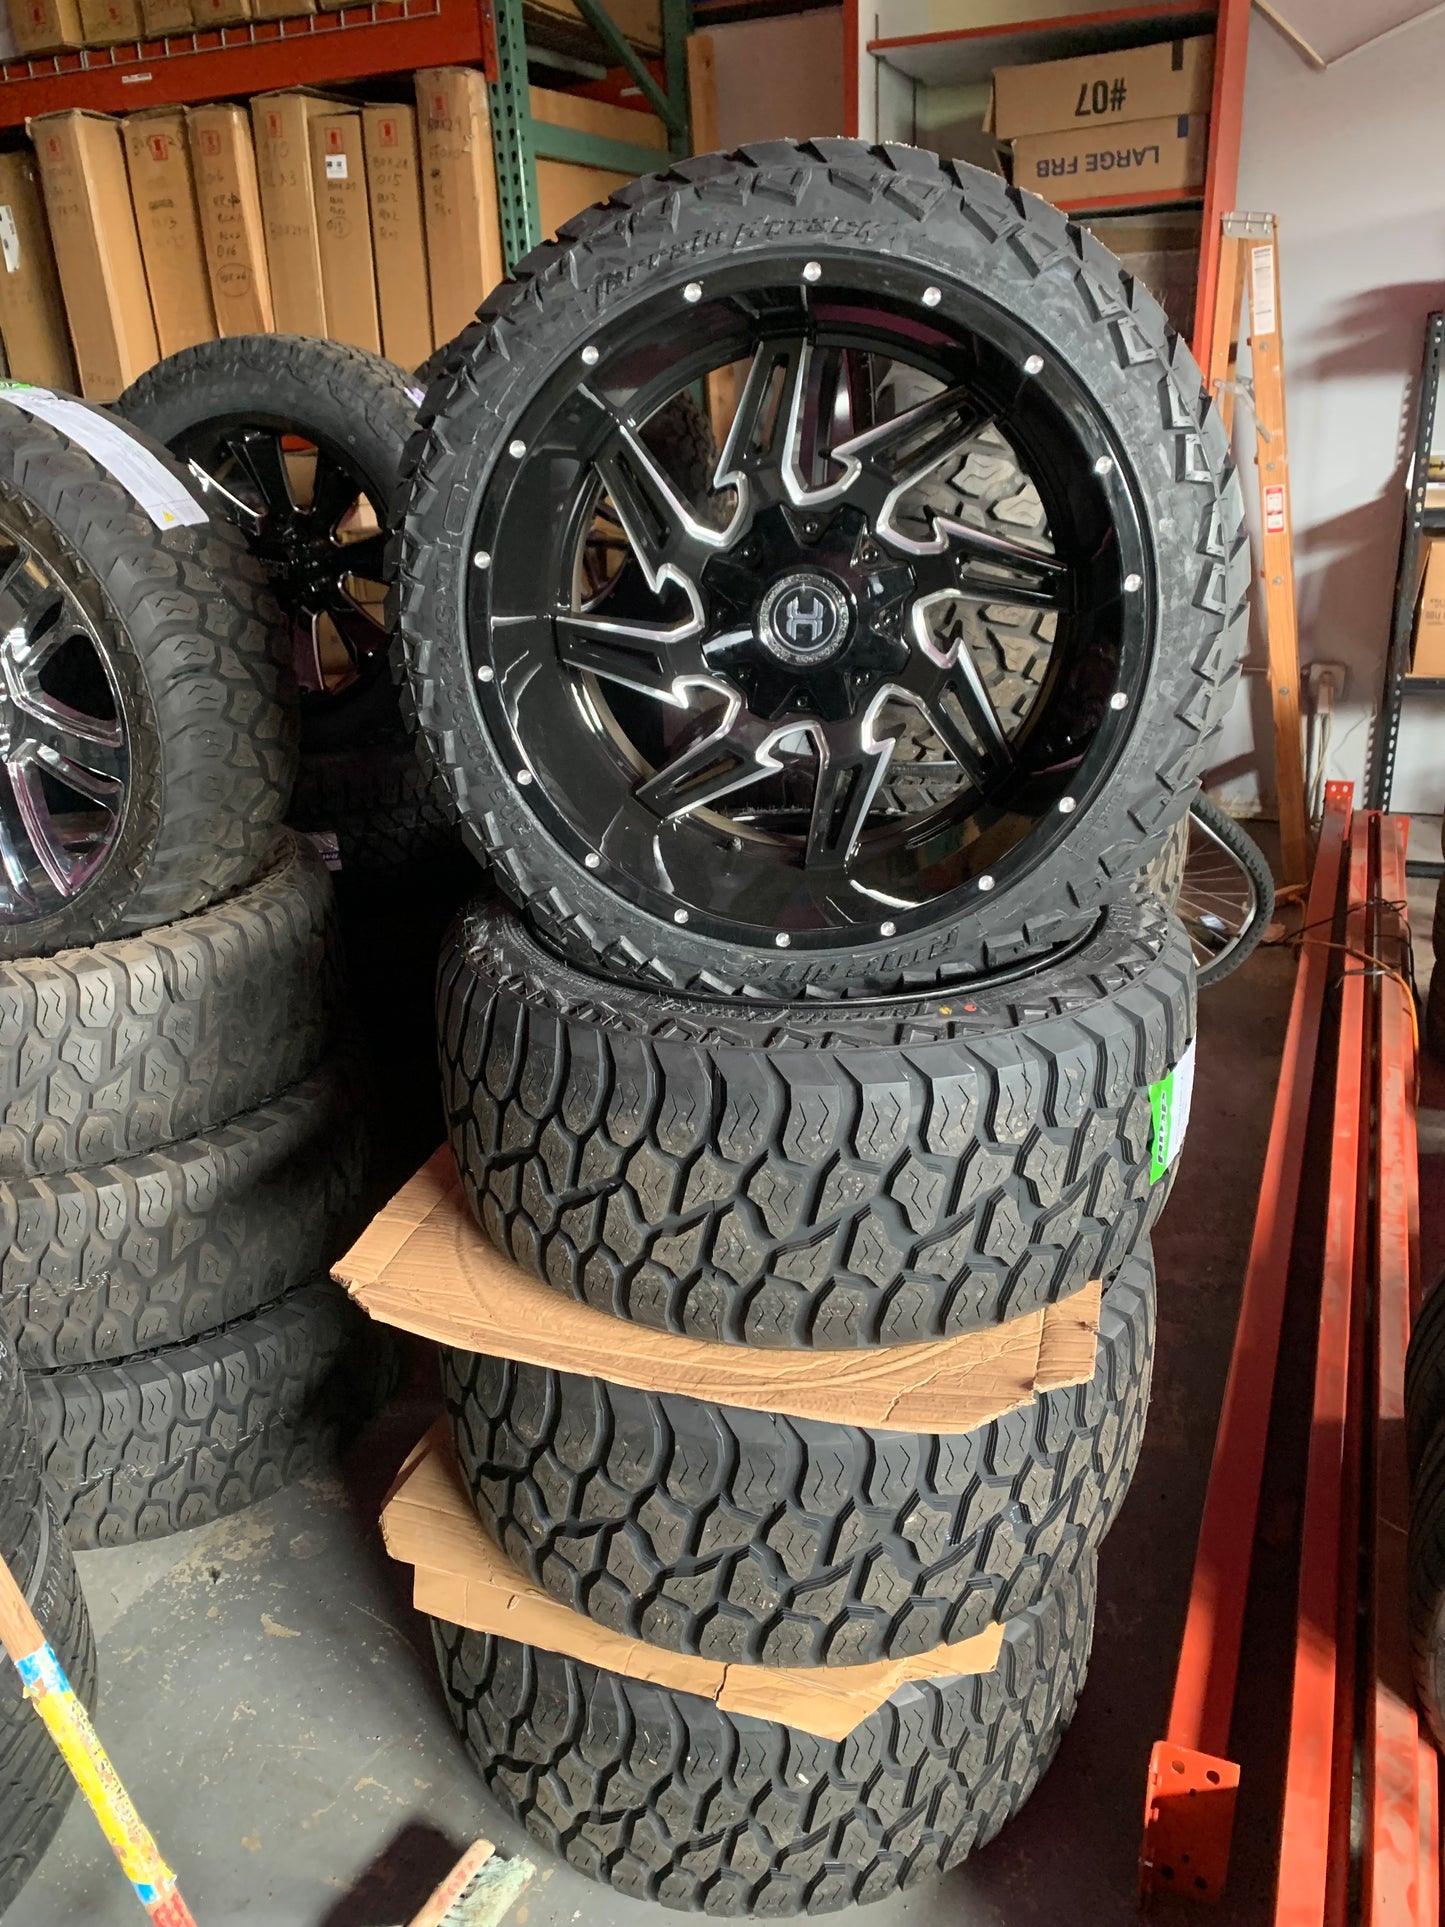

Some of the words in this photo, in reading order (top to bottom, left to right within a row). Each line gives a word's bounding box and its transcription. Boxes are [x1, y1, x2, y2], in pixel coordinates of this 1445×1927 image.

[1074, 77, 1127, 117] #07
[1036, 155, 1078, 178] FRB
[1084, 145, 1160, 171] LARGE
